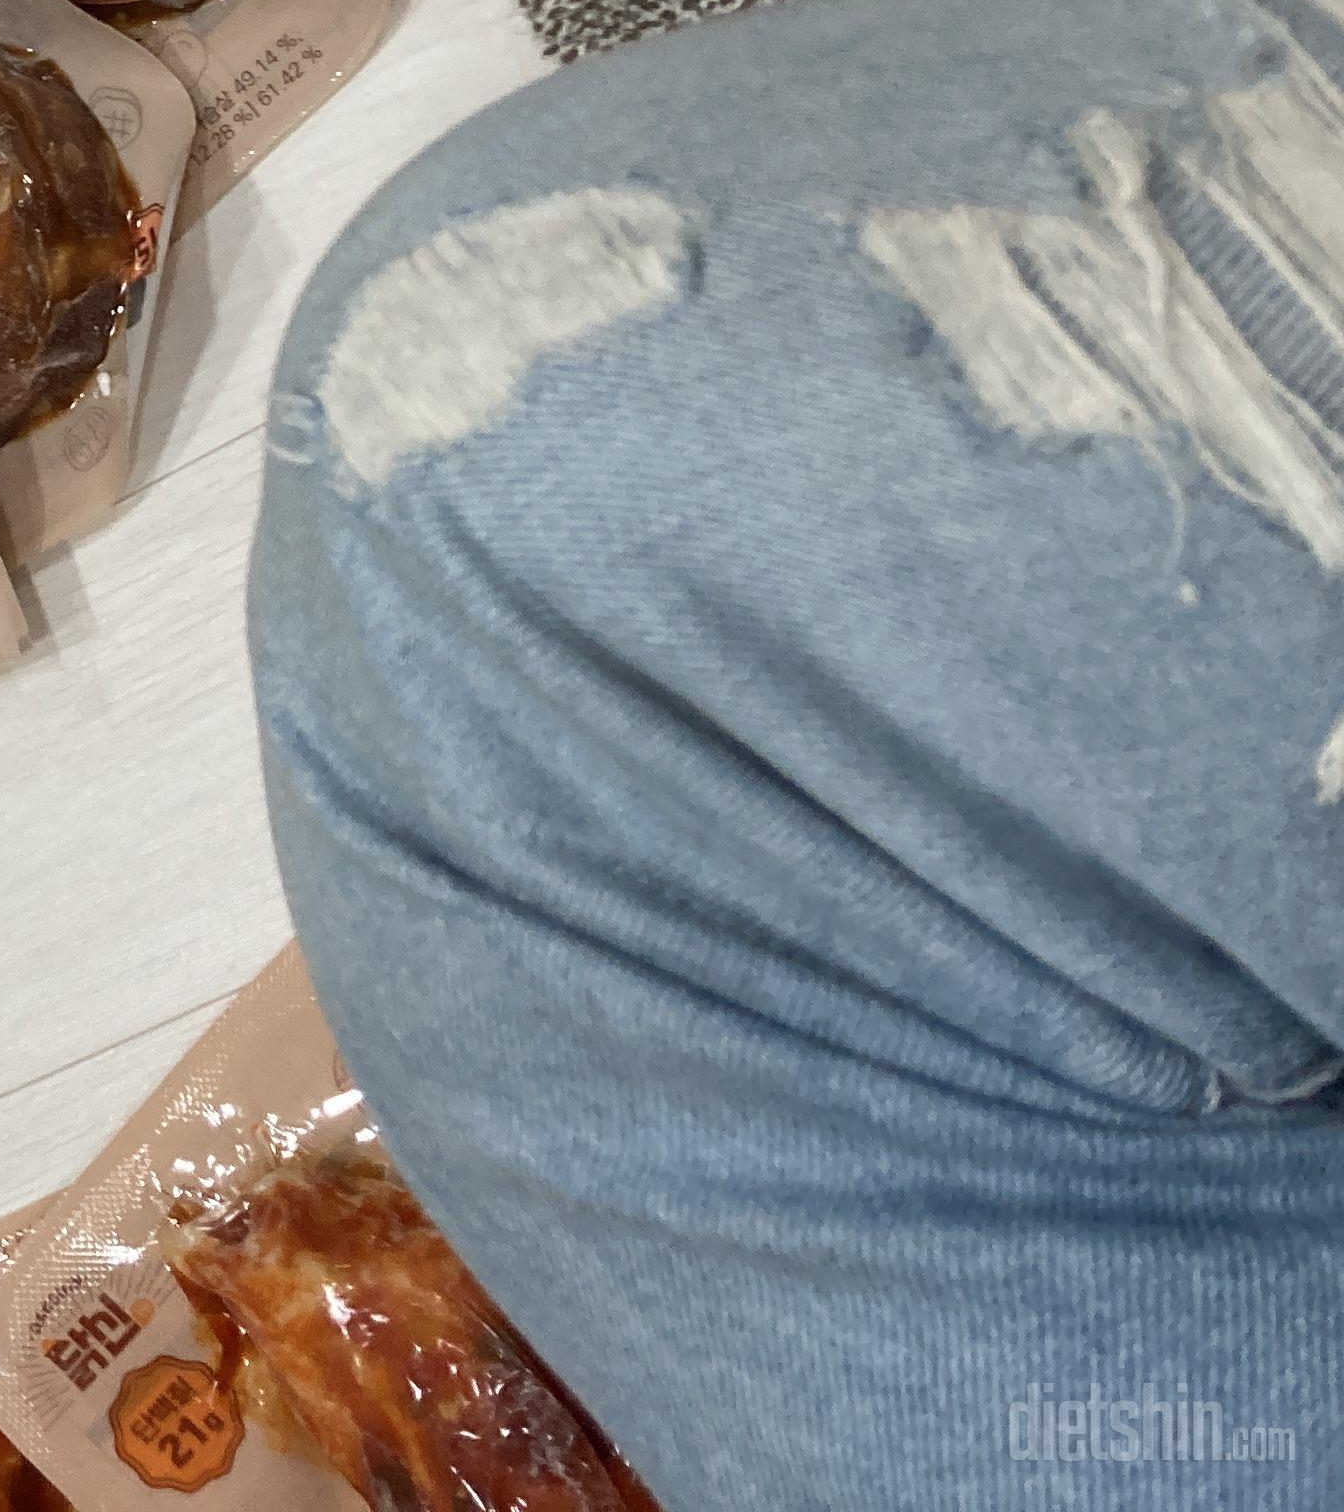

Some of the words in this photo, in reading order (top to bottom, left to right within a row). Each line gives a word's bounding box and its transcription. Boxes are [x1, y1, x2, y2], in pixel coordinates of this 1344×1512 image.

[231, 47, 279, 95] 49.14
[255, 60, 304, 108] 61.42
[299, 41, 324, 66] %
[45, 1292, 141, 1391] 닭신
[130, 1375, 197, 1444] 단백질
